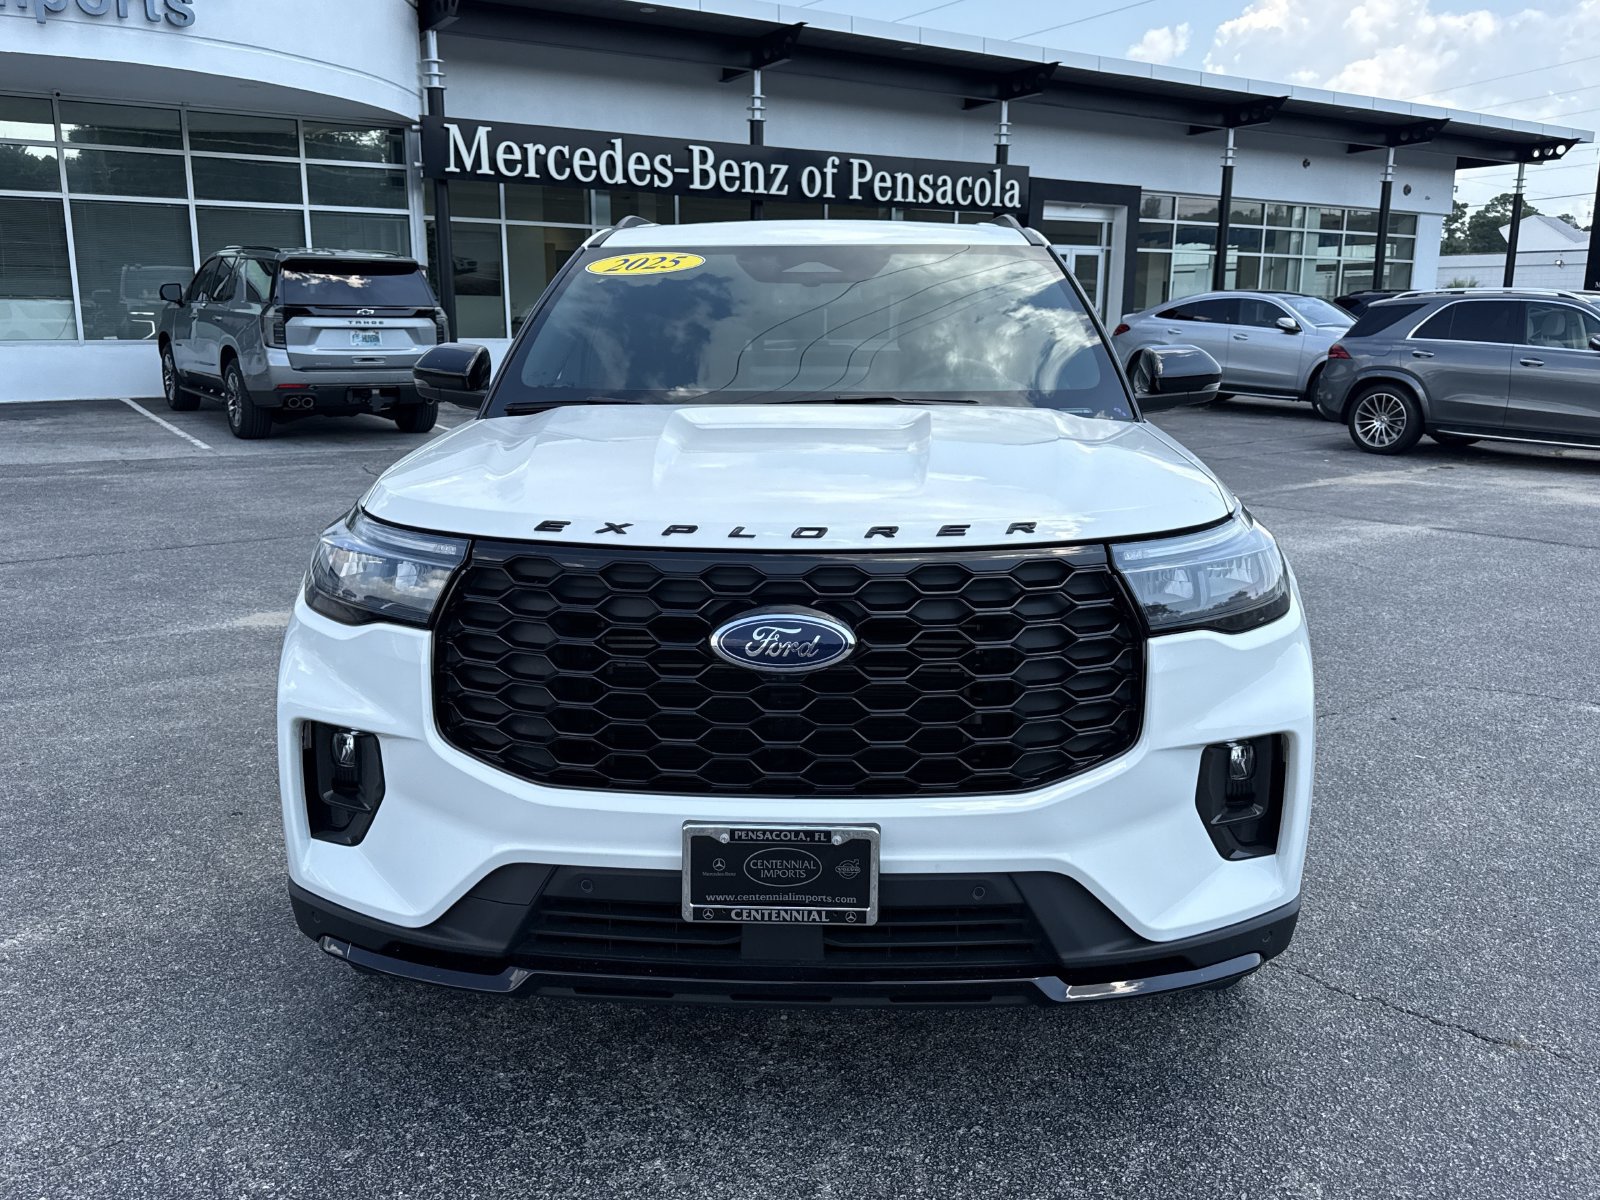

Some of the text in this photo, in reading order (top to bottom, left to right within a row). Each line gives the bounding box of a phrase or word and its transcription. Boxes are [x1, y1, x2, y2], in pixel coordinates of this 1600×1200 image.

[443, 122, 1021, 209] Mercedes-Benz of Pensacola
[603, 256, 689, 272] 2025
[534, 520, 1038, 539] EXPLORER
[745, 626, 821, 657] Ford
[734, 830, 828, 841] PENSACOLA, FL
[749, 859, 817, 870] CENTENNIAL
[760, 869, 807, 878] IMPORTS
[705, 892, 857, 904] www.centennialimports.com
[730, 909, 830, 922] CENTENNIAL
